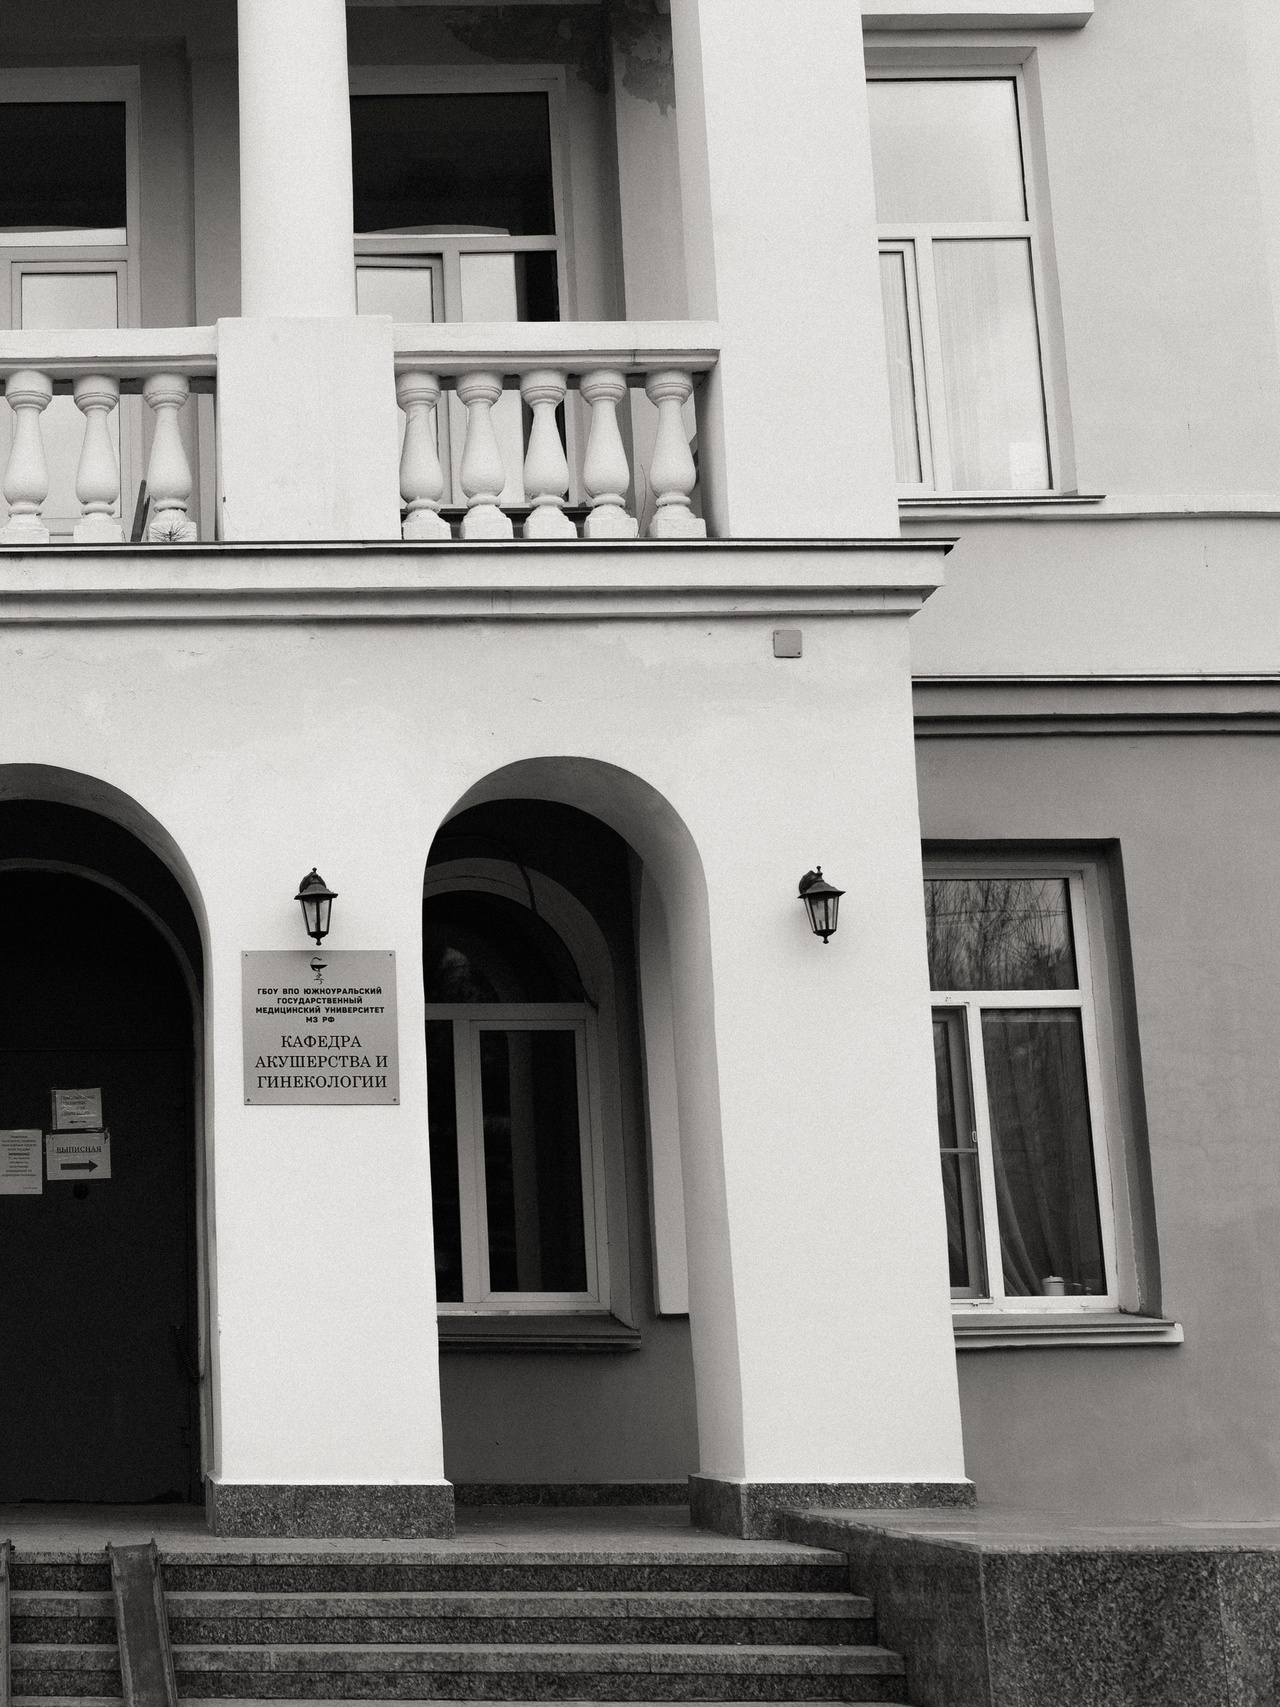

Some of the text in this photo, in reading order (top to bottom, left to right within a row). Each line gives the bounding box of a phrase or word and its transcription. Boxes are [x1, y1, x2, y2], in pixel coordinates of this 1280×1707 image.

[303, 987, 382, 995] ЮЖНОУРАЛЬСКИЙ
[277, 996, 363, 1005] ГОСУДАРСТВЕННЫЙ
[255, 1006, 385, 1015] МЕДИЦИНСКИЙ УНИВЕРСИТЕТ
[280, 1035, 362, 1050] КАФЕДРА
[254, 1055, 388, 1068] АКУШЕРСТВА И
[257, 1075, 388, 1088] ГИНЕКОЛОГИИ
[56, 1146, 102, 1154] ВЫПИСНАЯ
